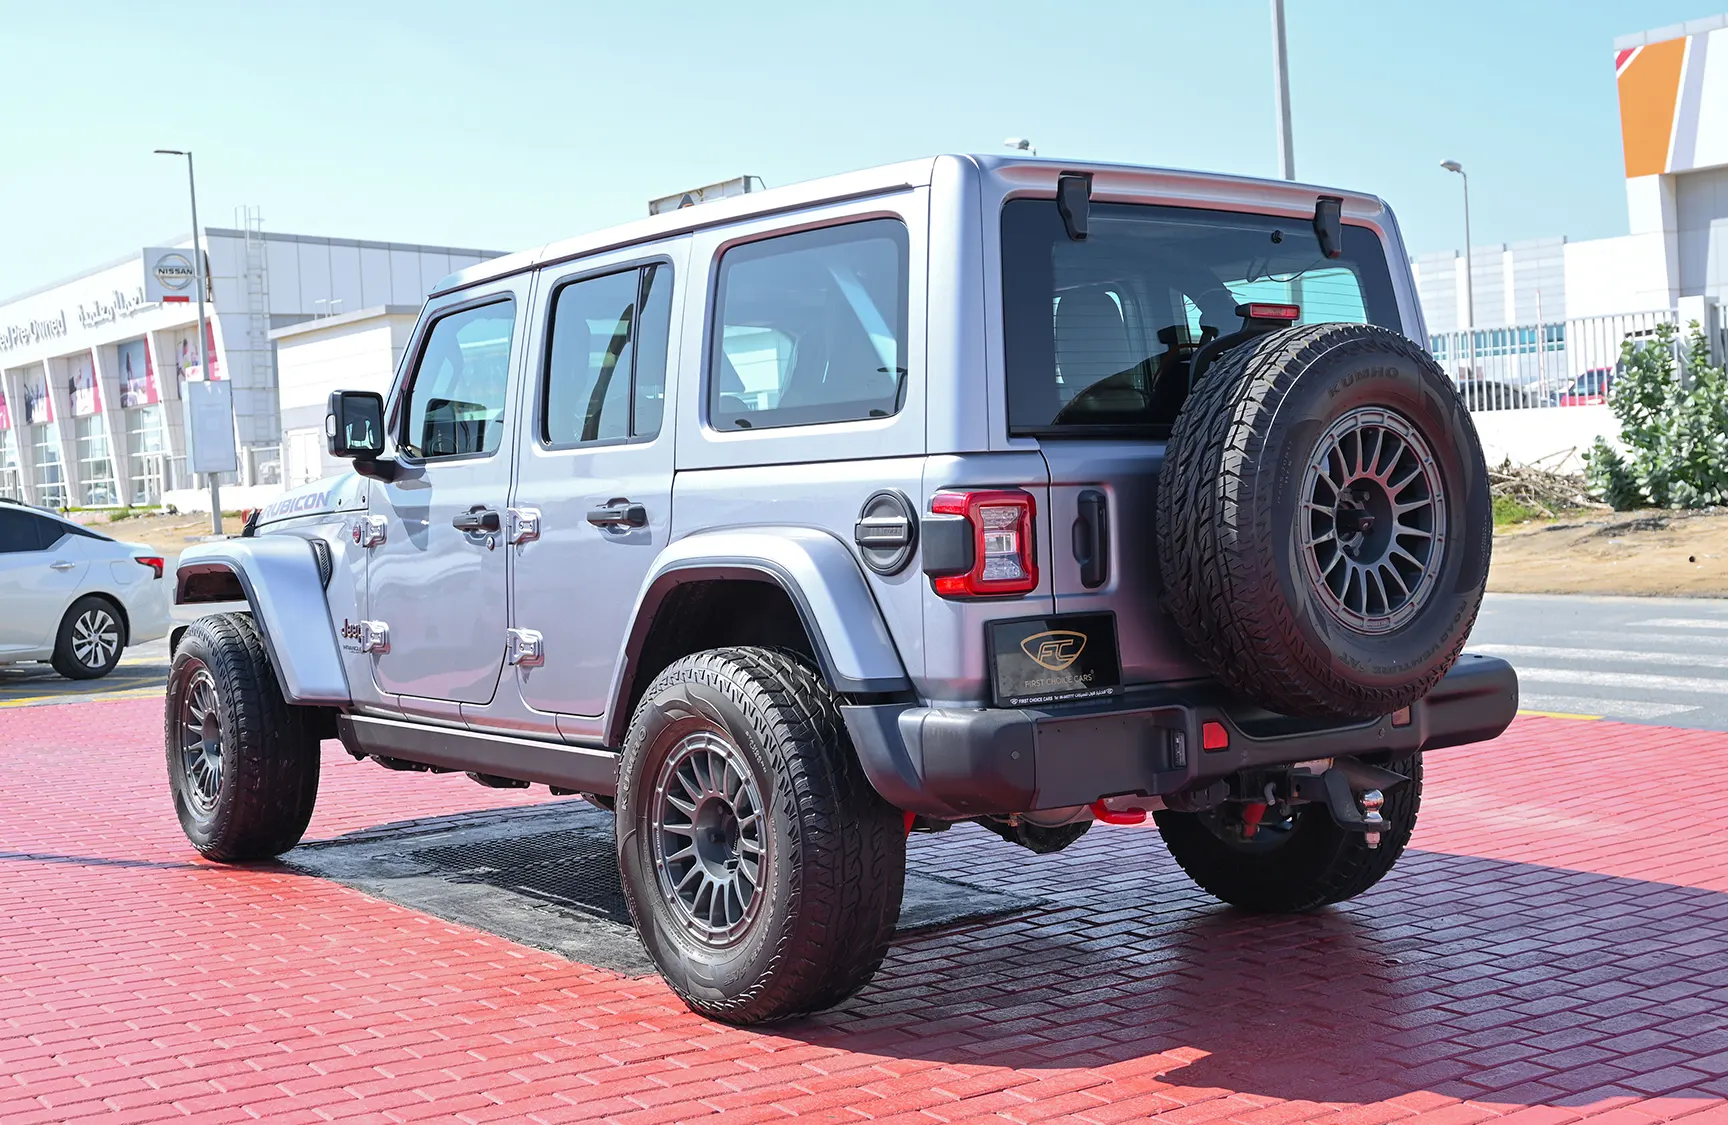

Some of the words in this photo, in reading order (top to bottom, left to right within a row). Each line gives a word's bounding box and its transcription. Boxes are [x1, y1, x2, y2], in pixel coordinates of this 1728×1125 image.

[157, 267, 193, 275] NISSAN
[12, 309, 67, 348] Pre-Owned
[1327, 366, 1400, 399] KUMHO
[264, 490, 334, 518] RUBICON
[1024, 679, 1045, 688] FIRST
[1046, 676, 1073, 686] CHOICE
[621, 725, 648, 811] KUMHO
